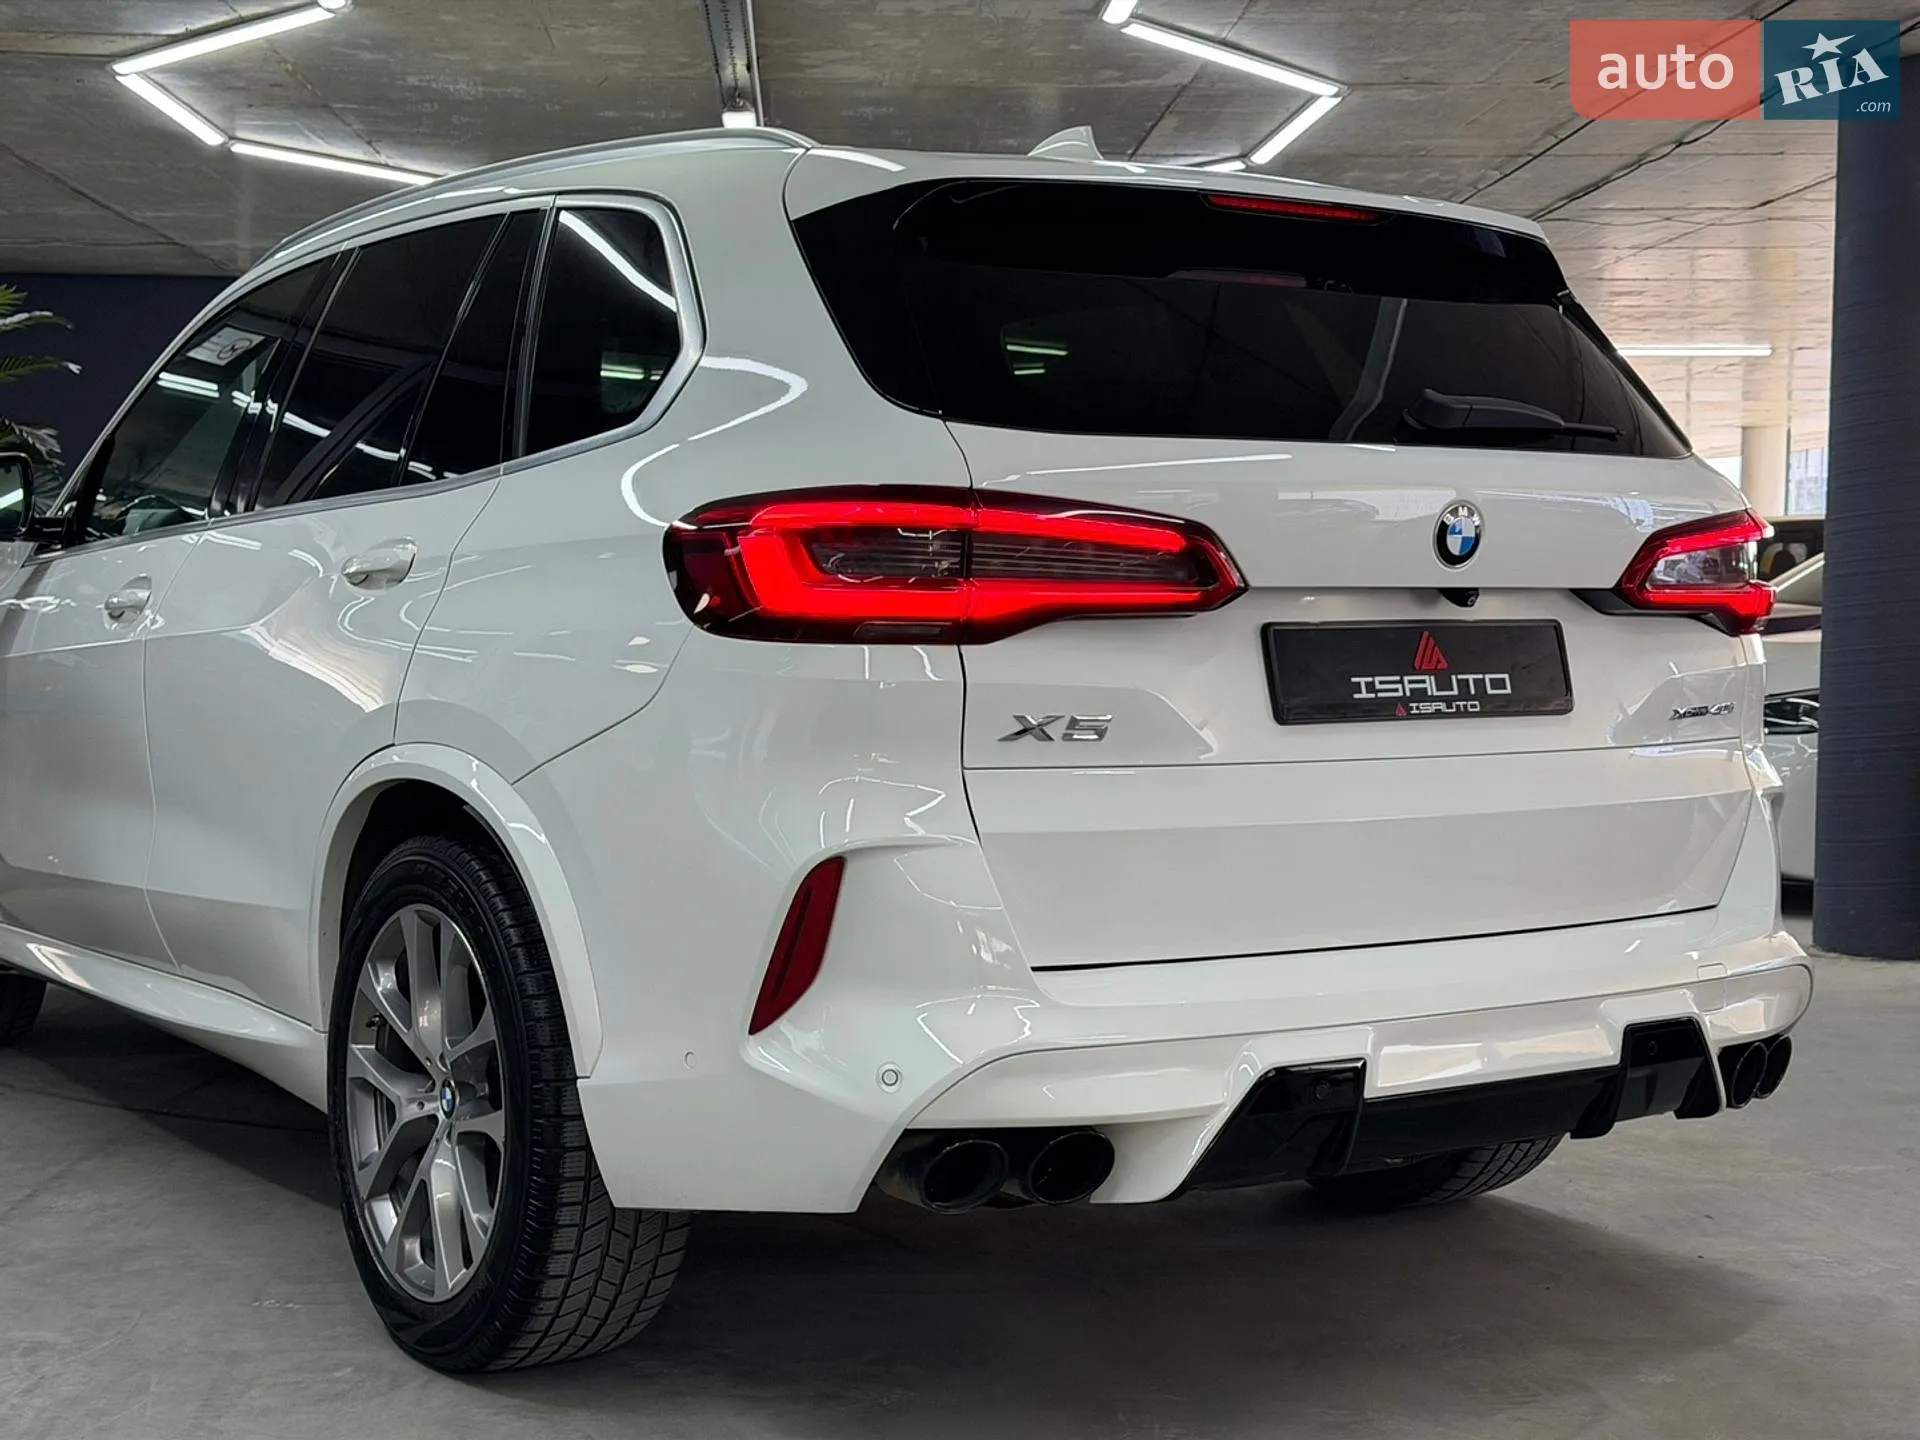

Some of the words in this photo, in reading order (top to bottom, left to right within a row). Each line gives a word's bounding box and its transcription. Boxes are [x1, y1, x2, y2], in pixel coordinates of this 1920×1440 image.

[1443, 506, 1481, 526] BMW
[1350, 673, 1512, 699] ISAUTO
[1409, 701, 1480, 714] ISAUTO
[997, 714, 1113, 742] X5
